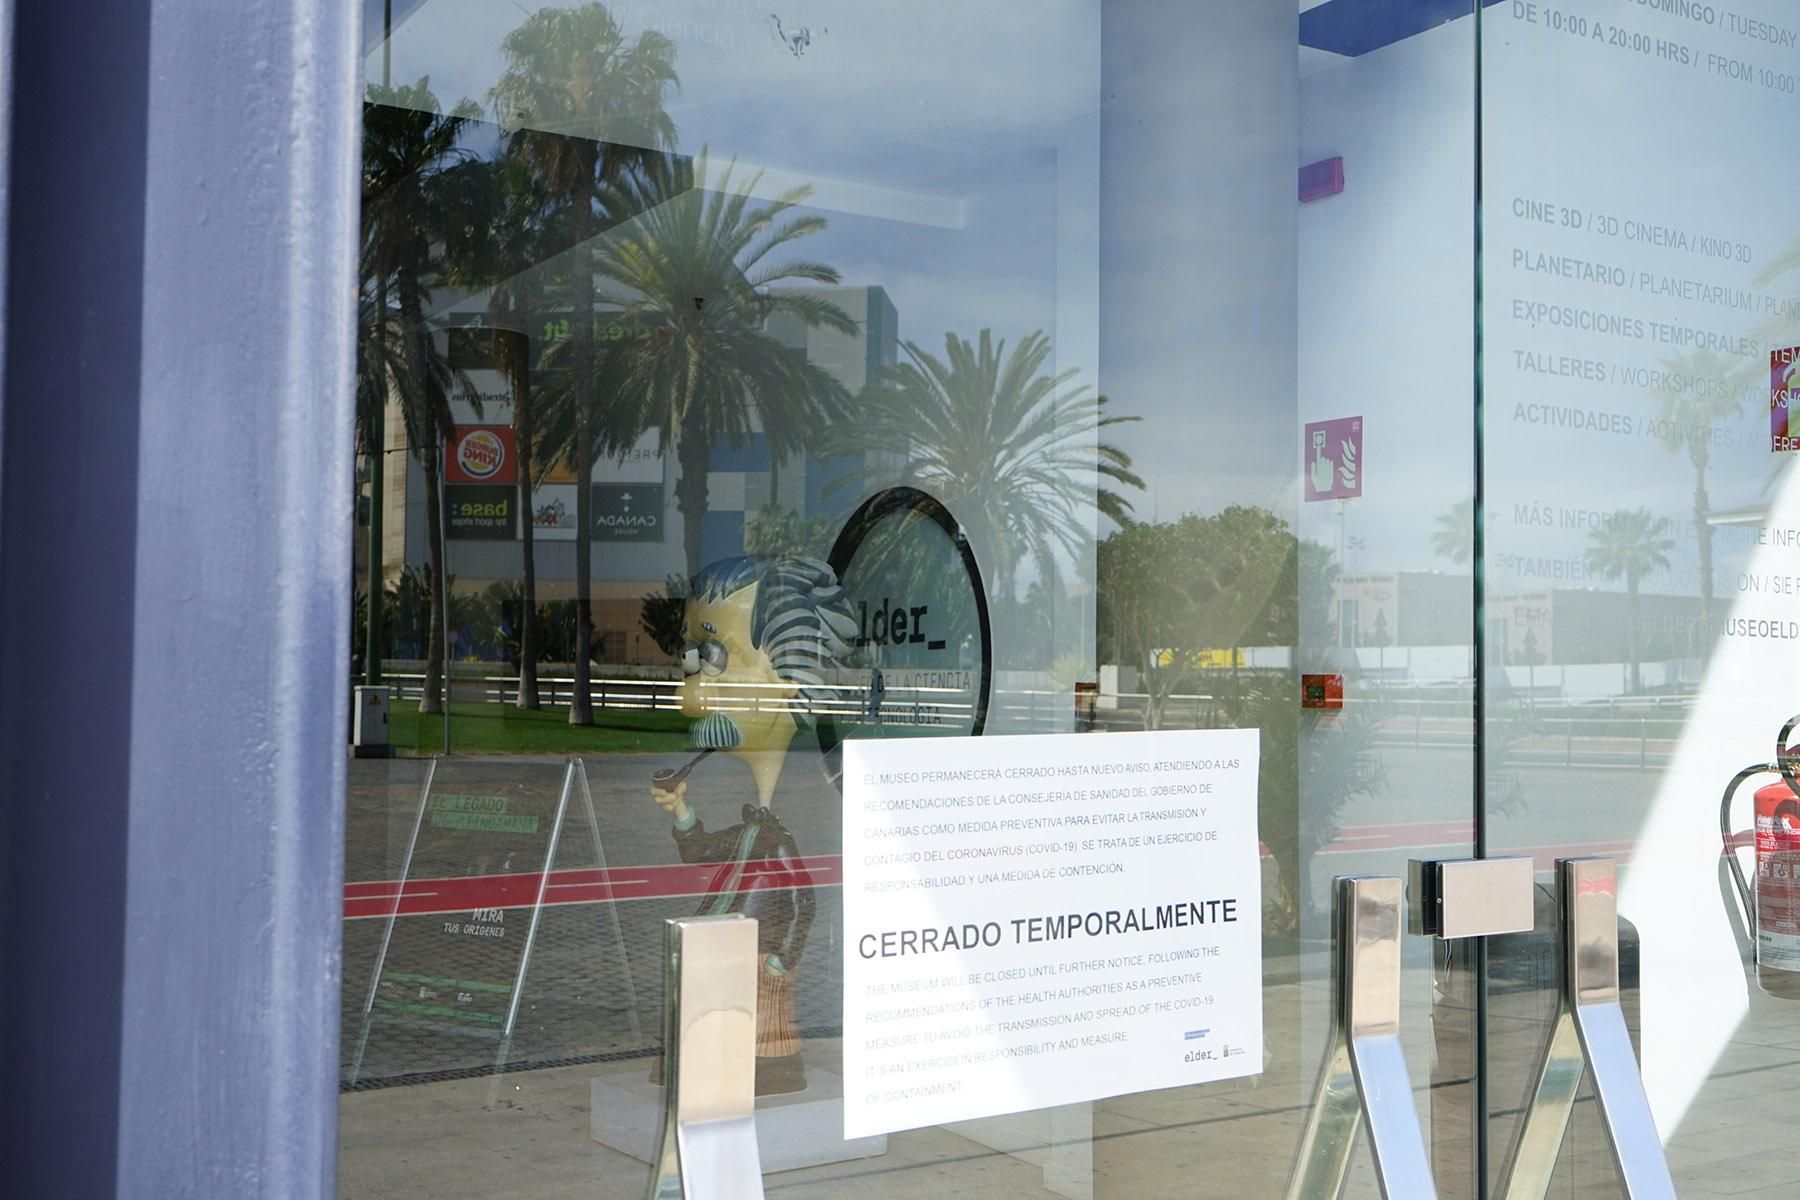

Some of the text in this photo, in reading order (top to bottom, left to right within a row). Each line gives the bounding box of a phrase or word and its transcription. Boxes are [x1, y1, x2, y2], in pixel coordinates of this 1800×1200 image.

[1512, 0, 1538, 24] DE
[1543, 8, 1588, 38] 10:00
[1592, 22, 1604, 43] A
[1608, 26, 1651, 54] 20:00
[1656, 38, 1690, 64] HRS
[1708, 53, 1753, 82] FROM
[1758, 68, 1794, 94] 10:00
[1727, 12, 1798, 49] TUESDAY
[1512, 197, 1555, 224] CINE
[1560, 207, 1582, 228] 3D
[1597, 215, 1618, 236] 3D
[1624, 220, 1688, 251] CINEMA
[1700, 236, 1732, 260] KINO
[1735, 243, 1752, 263] 3D
[1512, 248, 1626, 287] PLANETARIO
[1640, 272, 1752, 310] PLANETARIUM
[1512, 299, 1644, 340] EXPOSICIONES
[1650, 322, 1759, 358] TEMPORALES
[1514, 350, 1606, 382] TALLERES
[1621, 366, 1728, 400] WORKSHOPS
[1513, 402, 1633, 436] ACTIVIDADES
[1646, 418, 1734, 449] ACTIVITIES
[1514, 500, 1553, 527] MÁS
[1736, 572, 1759, 593] ON
[1773, 576, 1792, 594] SIE
[914, 671, 972, 691] CIENCIA
[864, 774, 877, 785] EL
[880, 772, 920, 784] MUSEO
[1004, 766, 1055, 780] CERRADO
[1058, 764, 1090, 776] HASTA
[1091, 764, 1125, 776] NUEVO
[1153, 760, 1214, 772] ATENDIENDO
[1214, 760, 1221, 769] A
[1222, 758, 1240, 769] LAS
[432, 795, 504, 812] EL LEGADO
[864, 783, 1212, 812] RECOMENDACIONES DE LA CONSEJERÍA DE SANIDAD DEL GOBIERNO DE
[864, 807, 1208, 840] CANARIAS COMO MEDIDA PREVENTIVA PARA EVITAR LA TRANSMISIÓN Y
[864, 850, 922, 866] CONTAGIO
[924, 850, 944, 862] DEL
[946, 844, 1024, 861] CORONAVIRUS
[1082, 840, 1095, 851] SE
[1098, 837, 1127, 849] TRATA
[1128, 836, 1141, 847] DE
[1142, 834, 1156, 846] UN
[1157, 831, 1202, 845] EJERCICIO
[1204, 830, 1218, 841] DE
[864, 874, 966, 893] RESPONSABILIDAD
[968, 874, 976, 884] Y
[977, 872, 1000, 884] UNA
[1001, 869, 1040, 882] MEDIDA
[1042, 868, 1056, 879] DE
[444, 922, 505, 937] TUS ORIGENES
[473, 908, 504, 922] MIRA
[859, 898, 1238, 959] CERRADO TEMPORALMENTE
[866, 984, 888, 996] THE
[890, 978, 939, 993] MUSEUM
[941, 974, 967, 988] WILL
[968, 972, 983, 985] BE
[984, 968, 1026, 984] CLOSED
[1028, 964, 1057, 978] UNTIL
[1058, 959, 1106, 974] FURTHER
[1148, 948, 1200, 964] FOLLOWING
[1202, 946, 1220, 957] THE
[865, 972, 1203, 1024] RECOMMENDATIONS OF THE HEALTH AUTHORITIES AS A PREVENTIVE
[864, 1034, 920, 1050] MEASURE
[924, 1032, 937, 1044] TO
[939, 1026, 972, 1040] AVOID
[975, 1024, 996, 1036] THE
[996, 1014, 1072, 1033] TRANSMISSION
[1073, 1010, 1094, 1024] AND
[1096, 1004, 1136, 1020] SPREAD
[1138, 1003, 1152, 1014] OF
[1154, 1000, 1172, 1012] THE
[888, 1064, 905, 1074] AN
[907, 1055, 960, 1072] EXERCISE
[962, 1054, 972, 1064] IN
[974, 1042, 1056, 1063] RESPONSIBILITY
[1058, 1038, 1078, 1050] AND
[1080, 1031, 1128, 1048] MEASURE
[866, 1080, 962, 1105] OF CONTAINMENT
